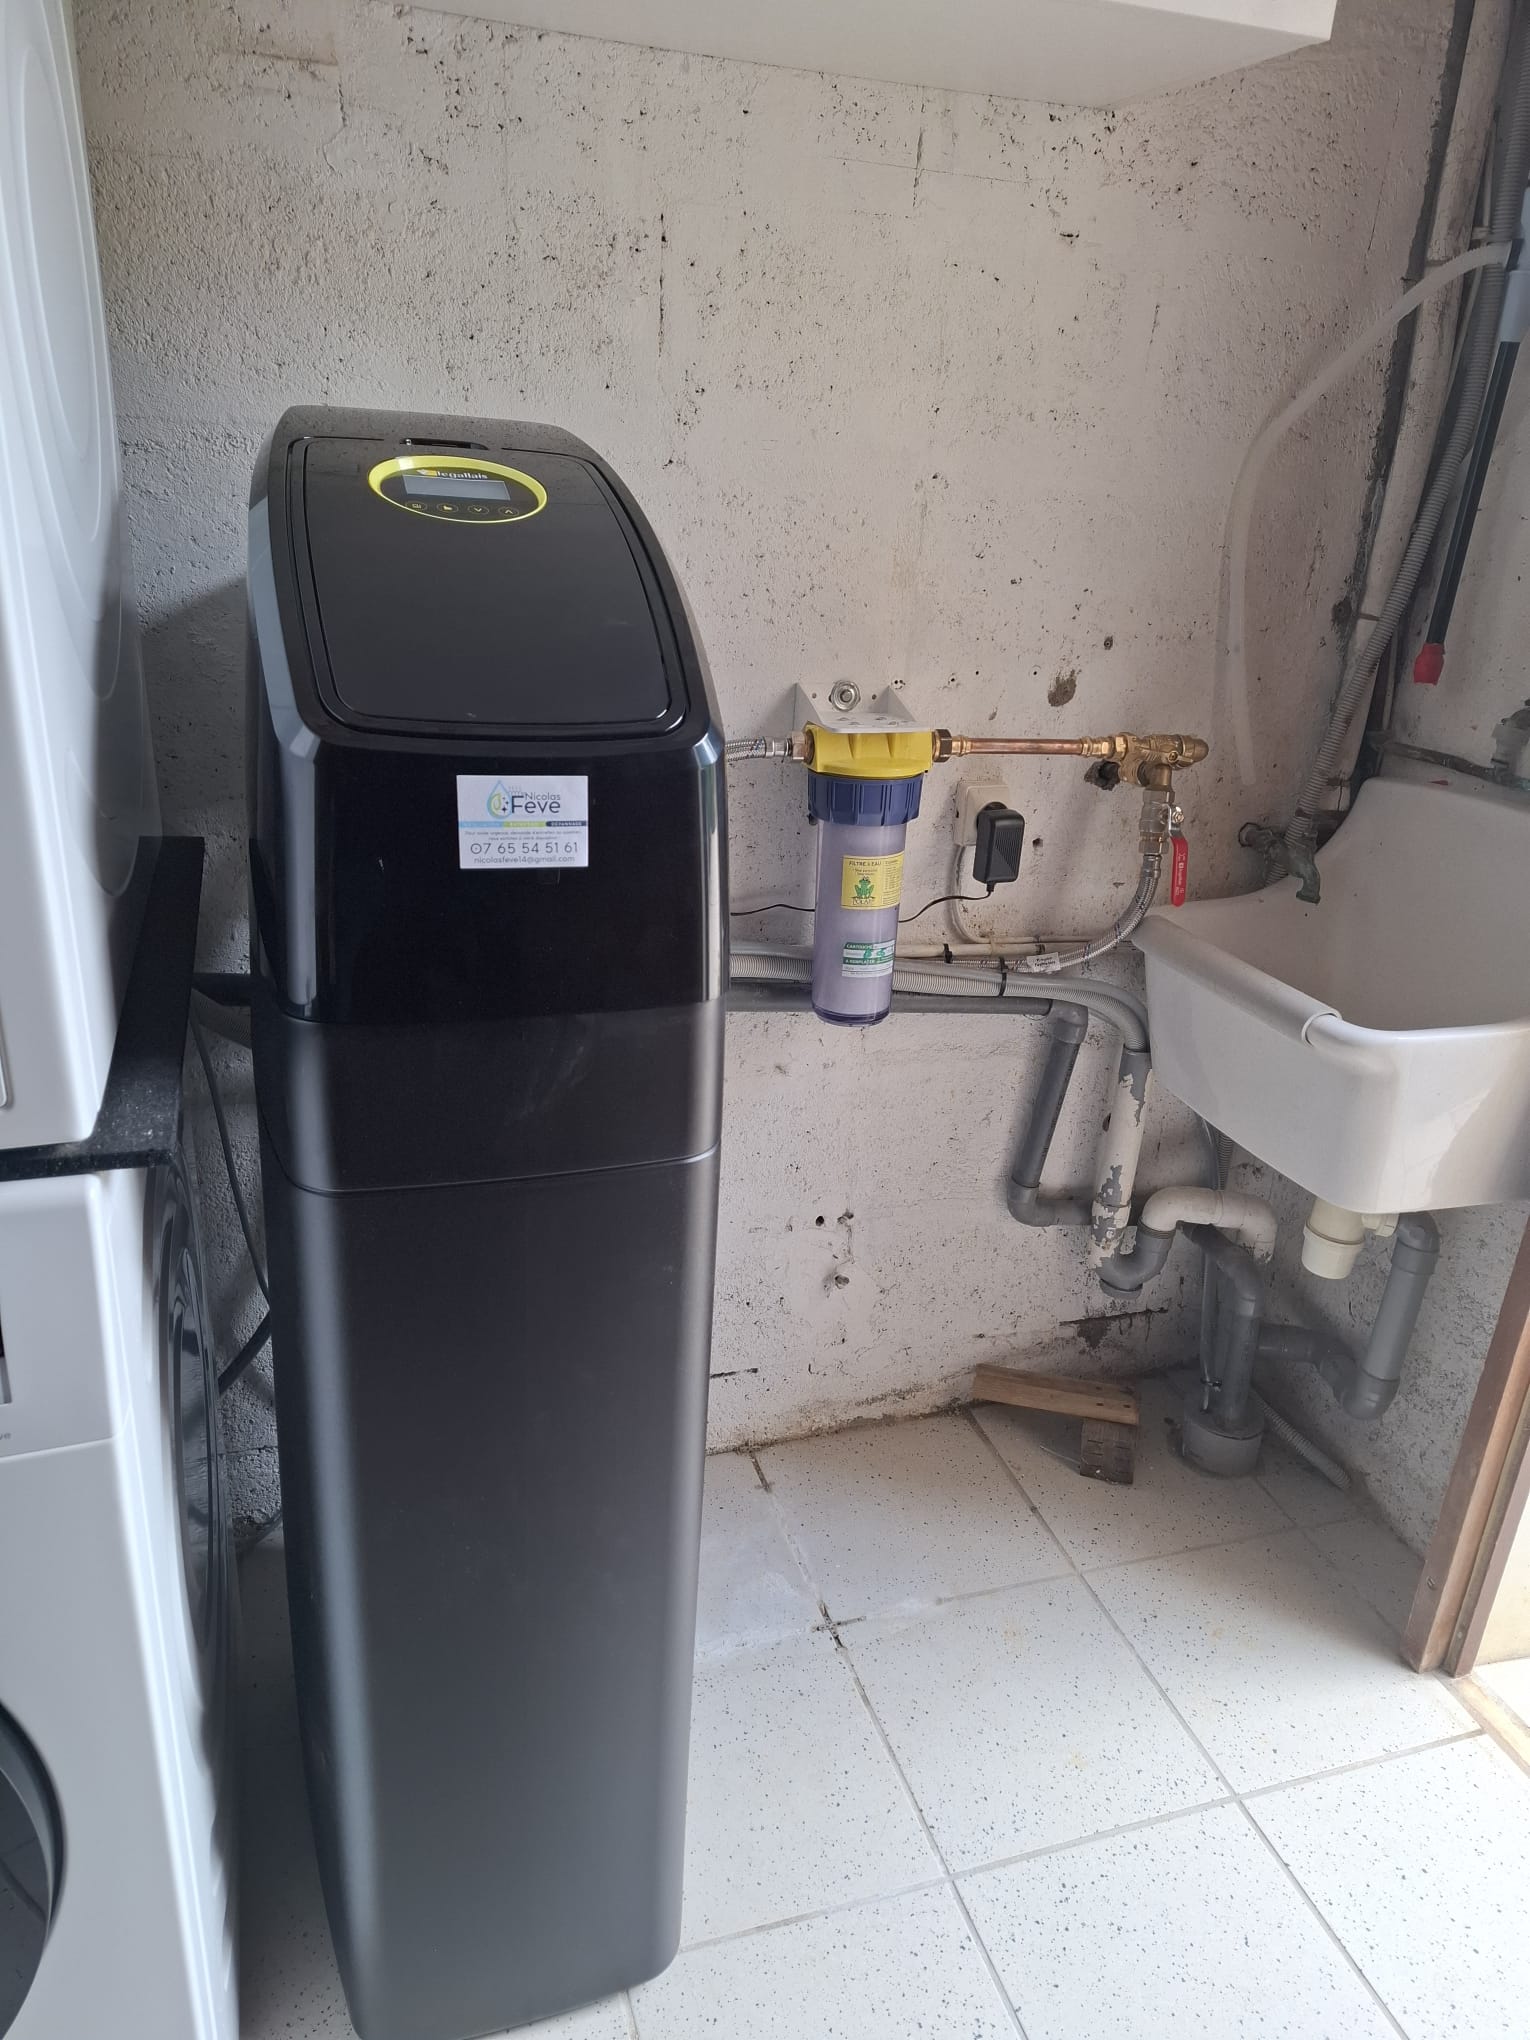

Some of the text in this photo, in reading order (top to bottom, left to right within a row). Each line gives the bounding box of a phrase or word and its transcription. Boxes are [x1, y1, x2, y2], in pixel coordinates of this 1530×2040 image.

[436, 471, 489, 480] legallais
[525, 792, 561, 801] Nicolas
[511, 796, 561, 814] Feve
[470, 842, 578, 855] 07 65 54 51 61
[474, 855, 575, 864] nicolasfeve14@gmail.com
